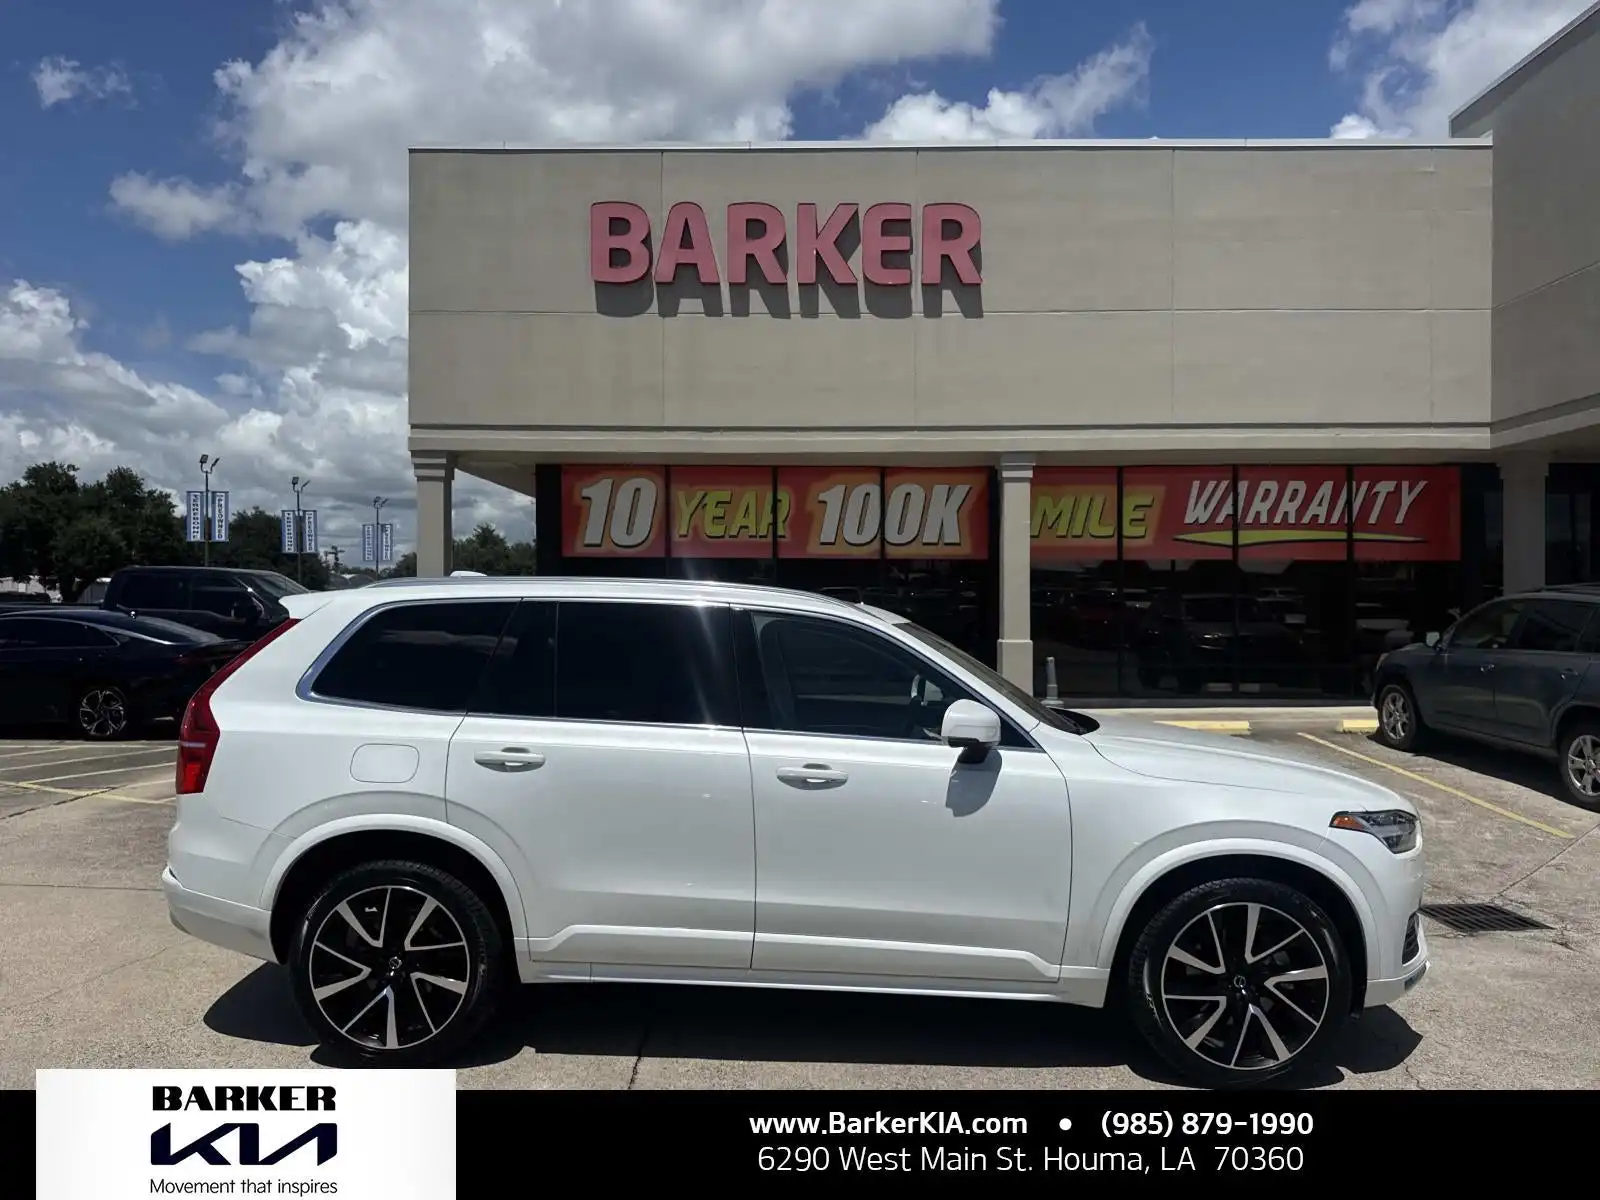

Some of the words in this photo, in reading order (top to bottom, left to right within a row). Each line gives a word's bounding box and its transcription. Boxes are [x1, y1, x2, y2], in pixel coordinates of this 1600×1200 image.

[590, 201, 983, 285] BARKER
[581, 477, 658, 547] 10
[677, 489, 790, 538] YEAR
[818, 483, 971, 545] 100K
[1030, 494, 1153, 538] MILE
[1183, 480, 1428, 525] WARRANTY
